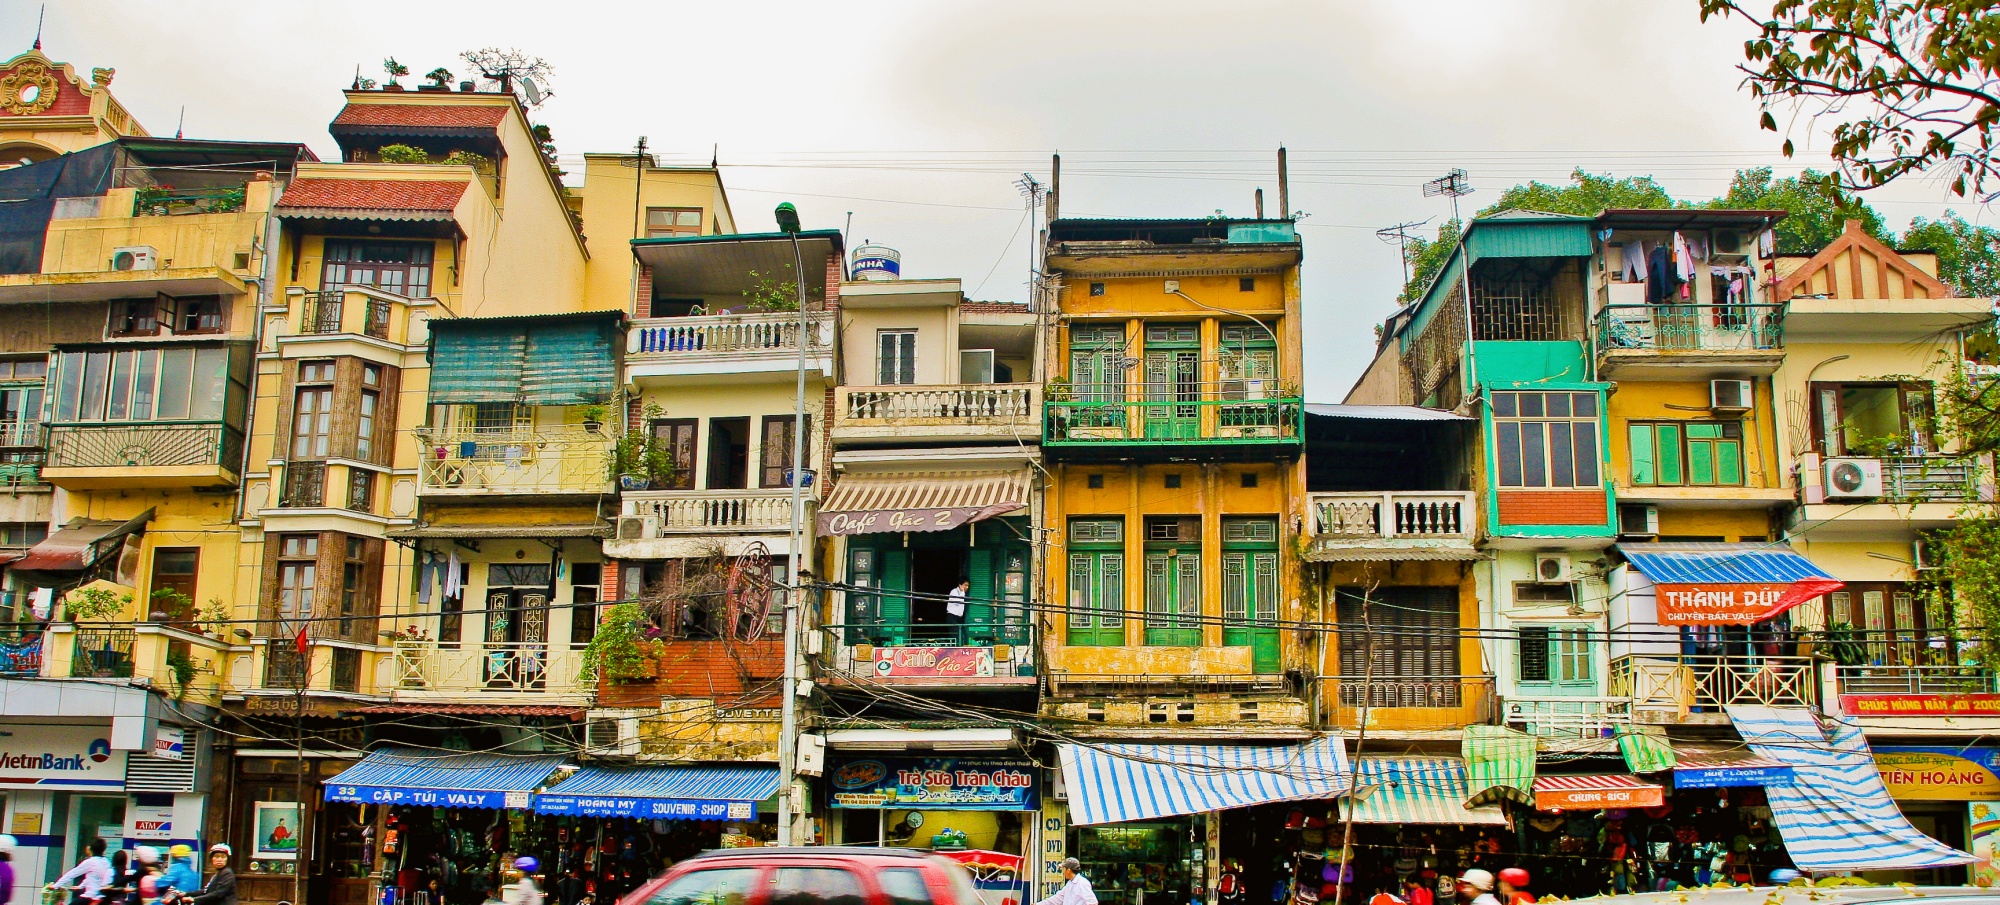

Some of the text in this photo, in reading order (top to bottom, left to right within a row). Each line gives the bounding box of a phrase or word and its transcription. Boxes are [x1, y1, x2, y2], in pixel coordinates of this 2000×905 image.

[867, 259, 884, 268] HÀ
[829, 511, 952, 534] Café Gác 2
[1666, 588, 1734, 608] THÀNH
[894, 648, 976, 675] Café Gác 2
[246, 697, 314, 711] Elizabeh
[1858, 699, 1888, 710] CHÚC
[1891, 698, 1921, 710] MỪNG
[1924, 698, 1948, 710] NĂM
[156, 741, 168, 750] ATM
[898, 769, 921, 785] Trà
[925, 770, 952, 786] Sữa
[956, 770, 989, 786] Trân
[992, 769, 1031, 787] Châu
[1880, 768, 1984, 784] TIÊN HOÀNG
[338, 787, 356, 795] 33
[414, 790, 437, 802] TÚI
[447, 794, 486, 804] VALY
[1568, 793, 1601, 802] CHUNG
[652, 803, 696, 815] SOUVENIR
[701, 804, 725, 815] SHOP
[140, 822, 156, 830] ATM
[1046, 818, 1060, 831] CD
[1046, 840, 1062, 853] DVD
